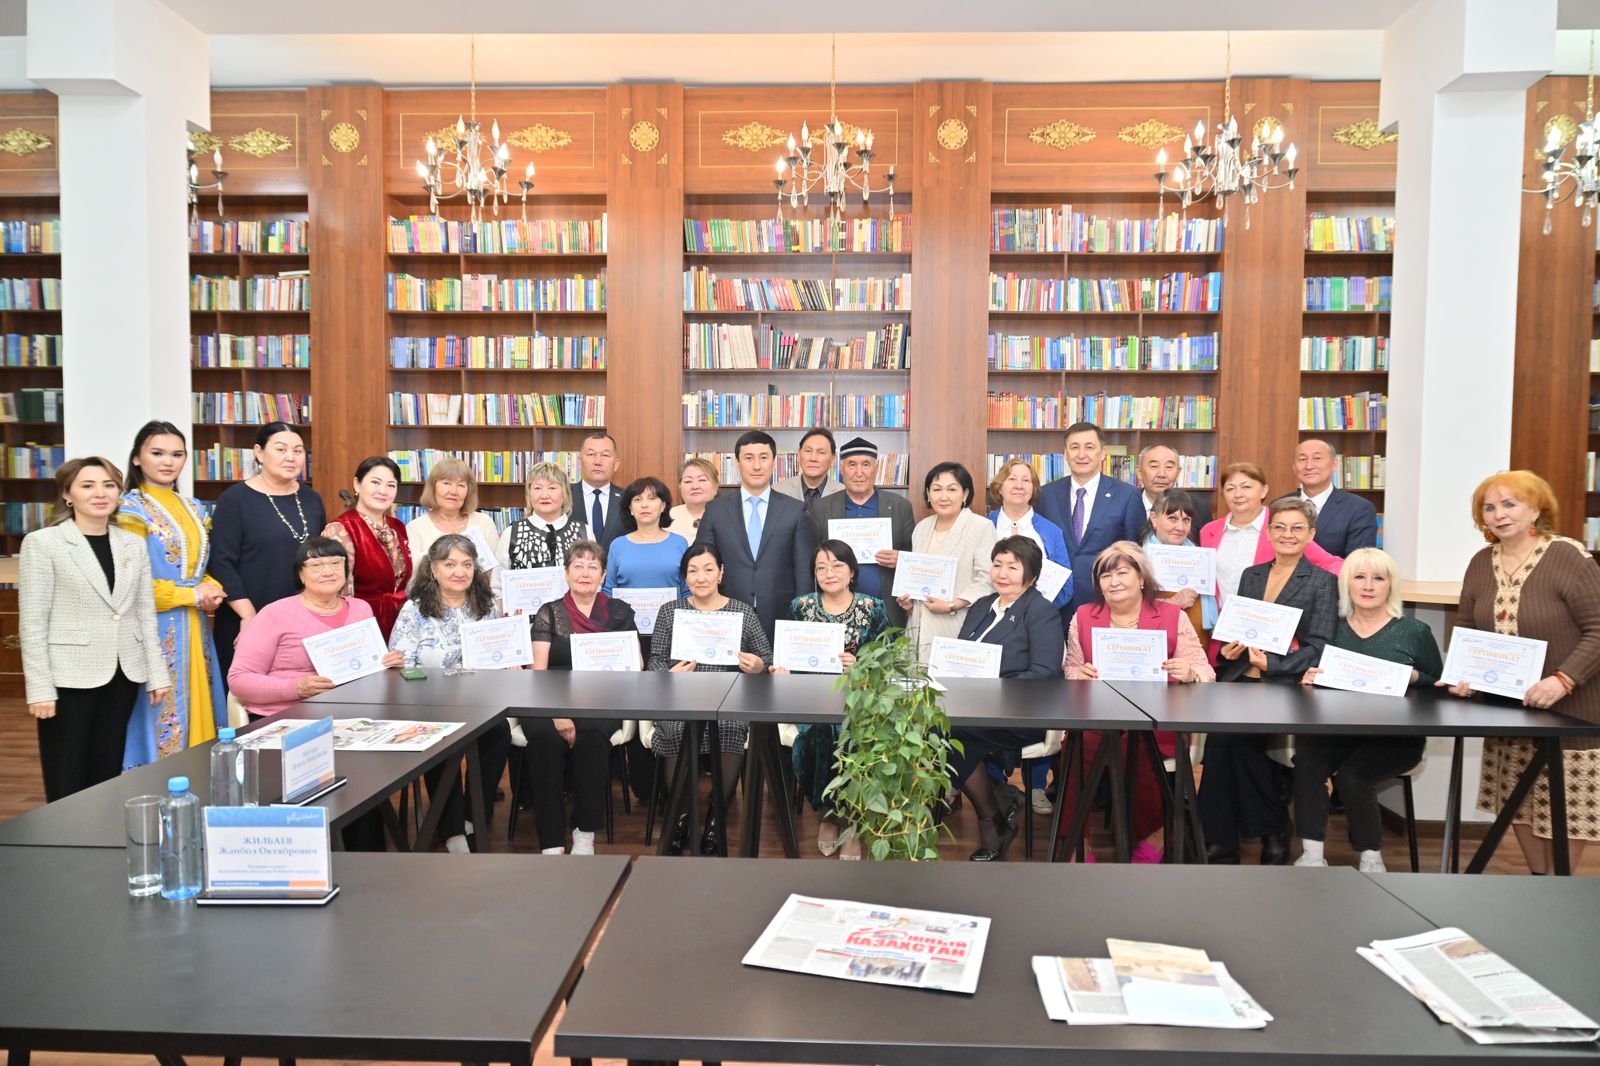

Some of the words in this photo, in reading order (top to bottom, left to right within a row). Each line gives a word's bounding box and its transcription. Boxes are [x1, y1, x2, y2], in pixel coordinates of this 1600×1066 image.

[1161, 559, 1200, 567] СЕРТИФИКАТ
[515, 581, 553, 590] СЕРТИФИКАТ
[1235, 610, 1281, 625] СЕРТИФИКАТ
[474, 631, 514, 642] СЕРТИФИКАТ
[790, 635, 831, 643] СЕРТИФИКАТ
[324, 638, 366, 655] СЕРТИФИКАТ
[585, 647, 623, 655] СЕРТИФИКАТ
[1107, 644, 1152, 653] СЕРТИФИКАТ
[1467, 646, 1521, 663] СЕРТИФИКАТ
[944, 654, 986, 665] СЕРТИФИКАТ
[242, 836, 293, 845] ЖИЛБАЕВ
[218, 847, 257, 855] Жанбол
[845, 935, 966, 957] КАЗАХСТАН
